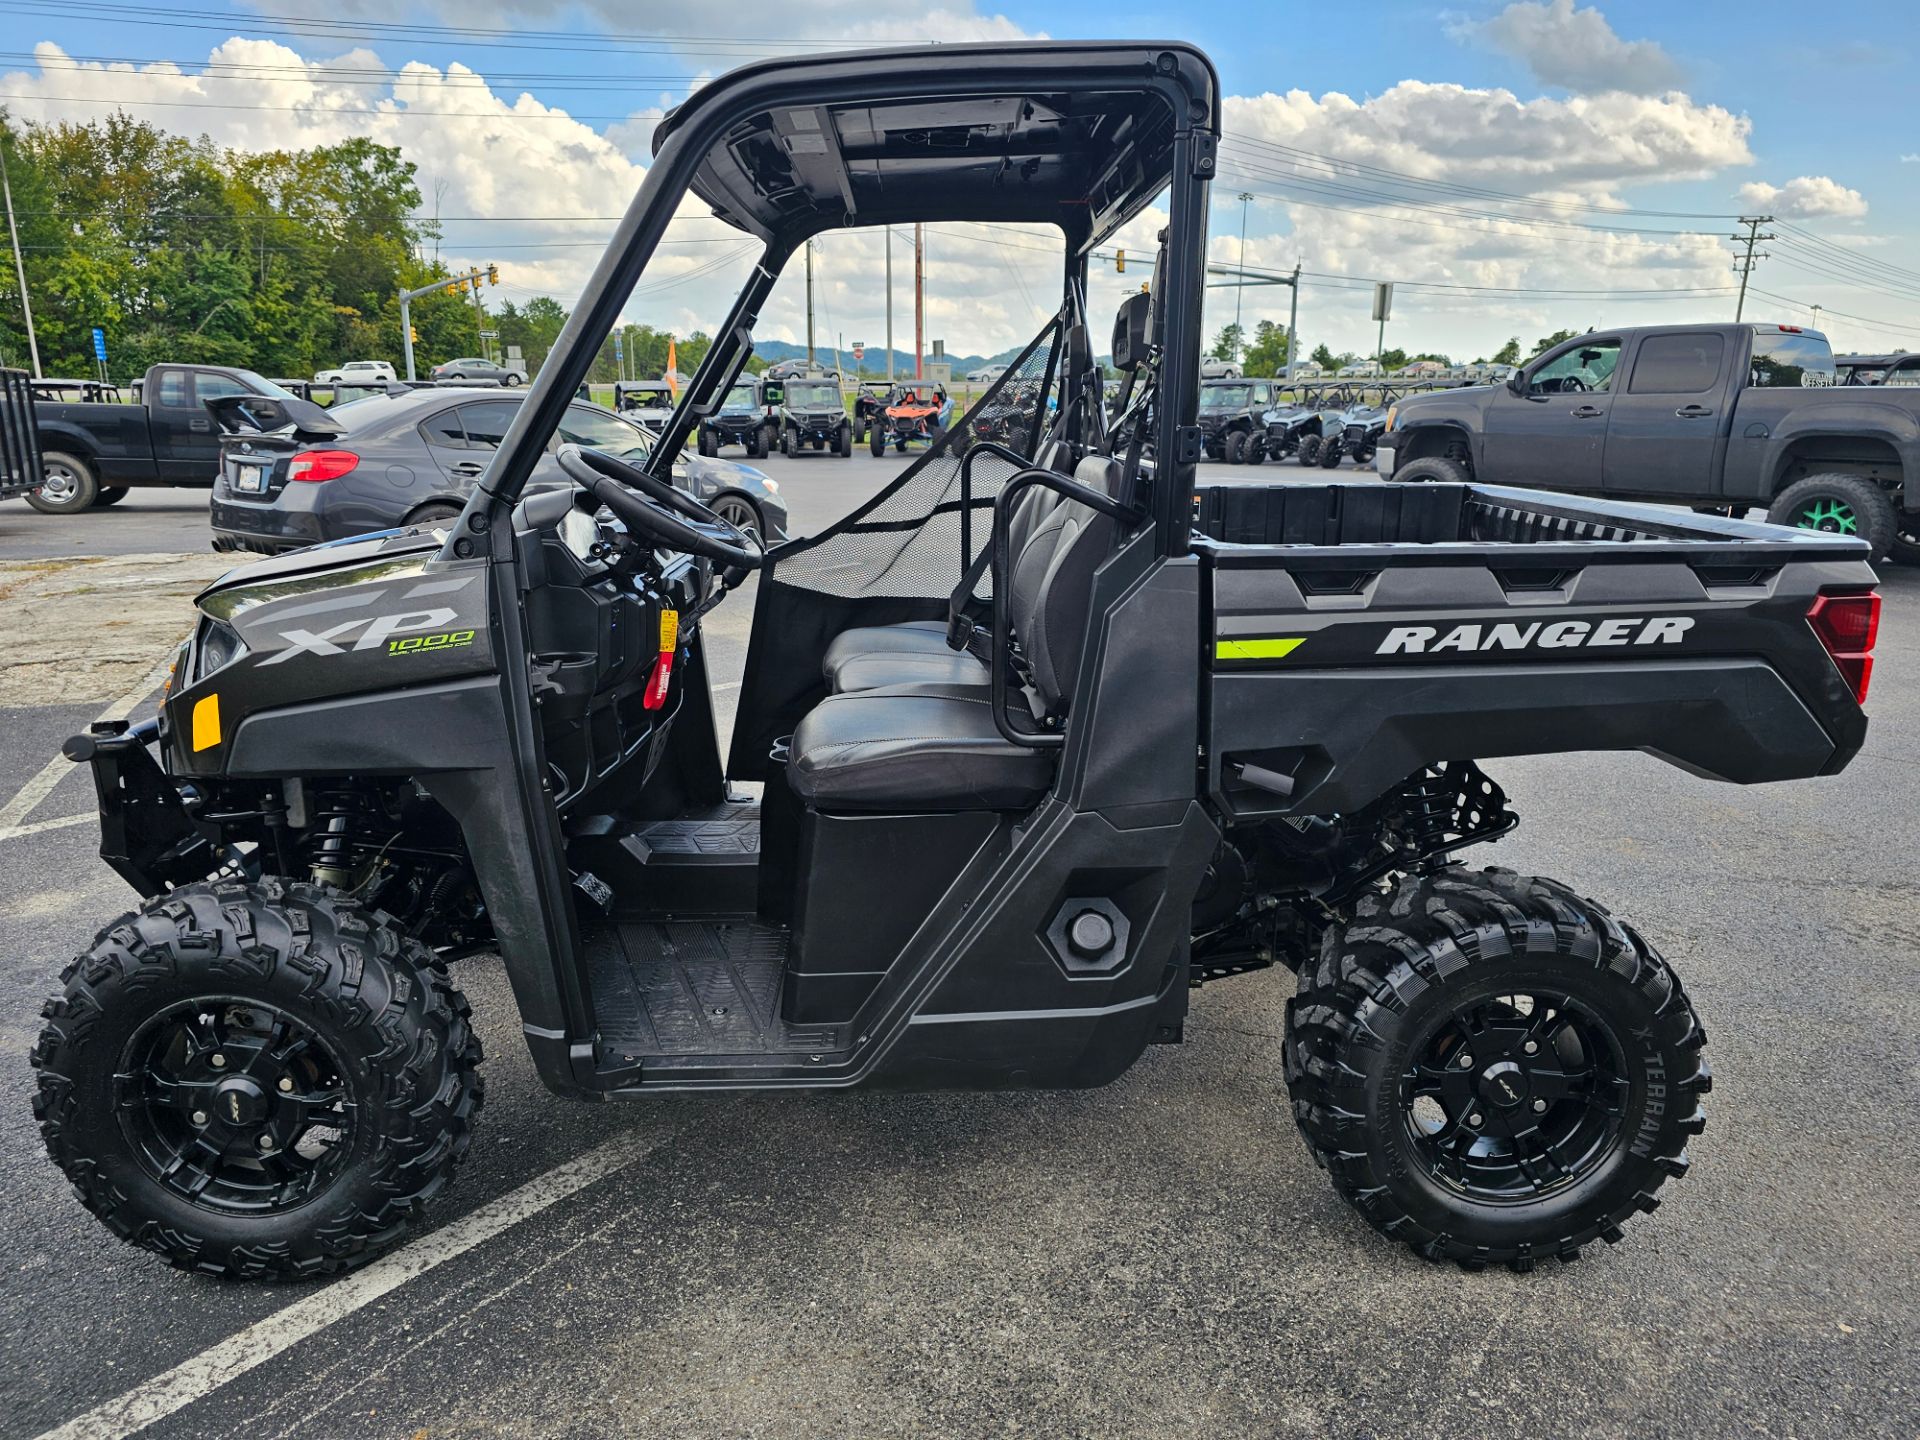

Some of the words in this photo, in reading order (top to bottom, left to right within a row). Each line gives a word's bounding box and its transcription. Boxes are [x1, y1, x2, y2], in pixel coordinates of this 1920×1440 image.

[253, 607, 458, 667] XP
[389, 630, 475, 652] 1000
[1375, 616, 1696, 655] RANGER
[1629, 1026, 1667, 1160] X-TERRAIN
